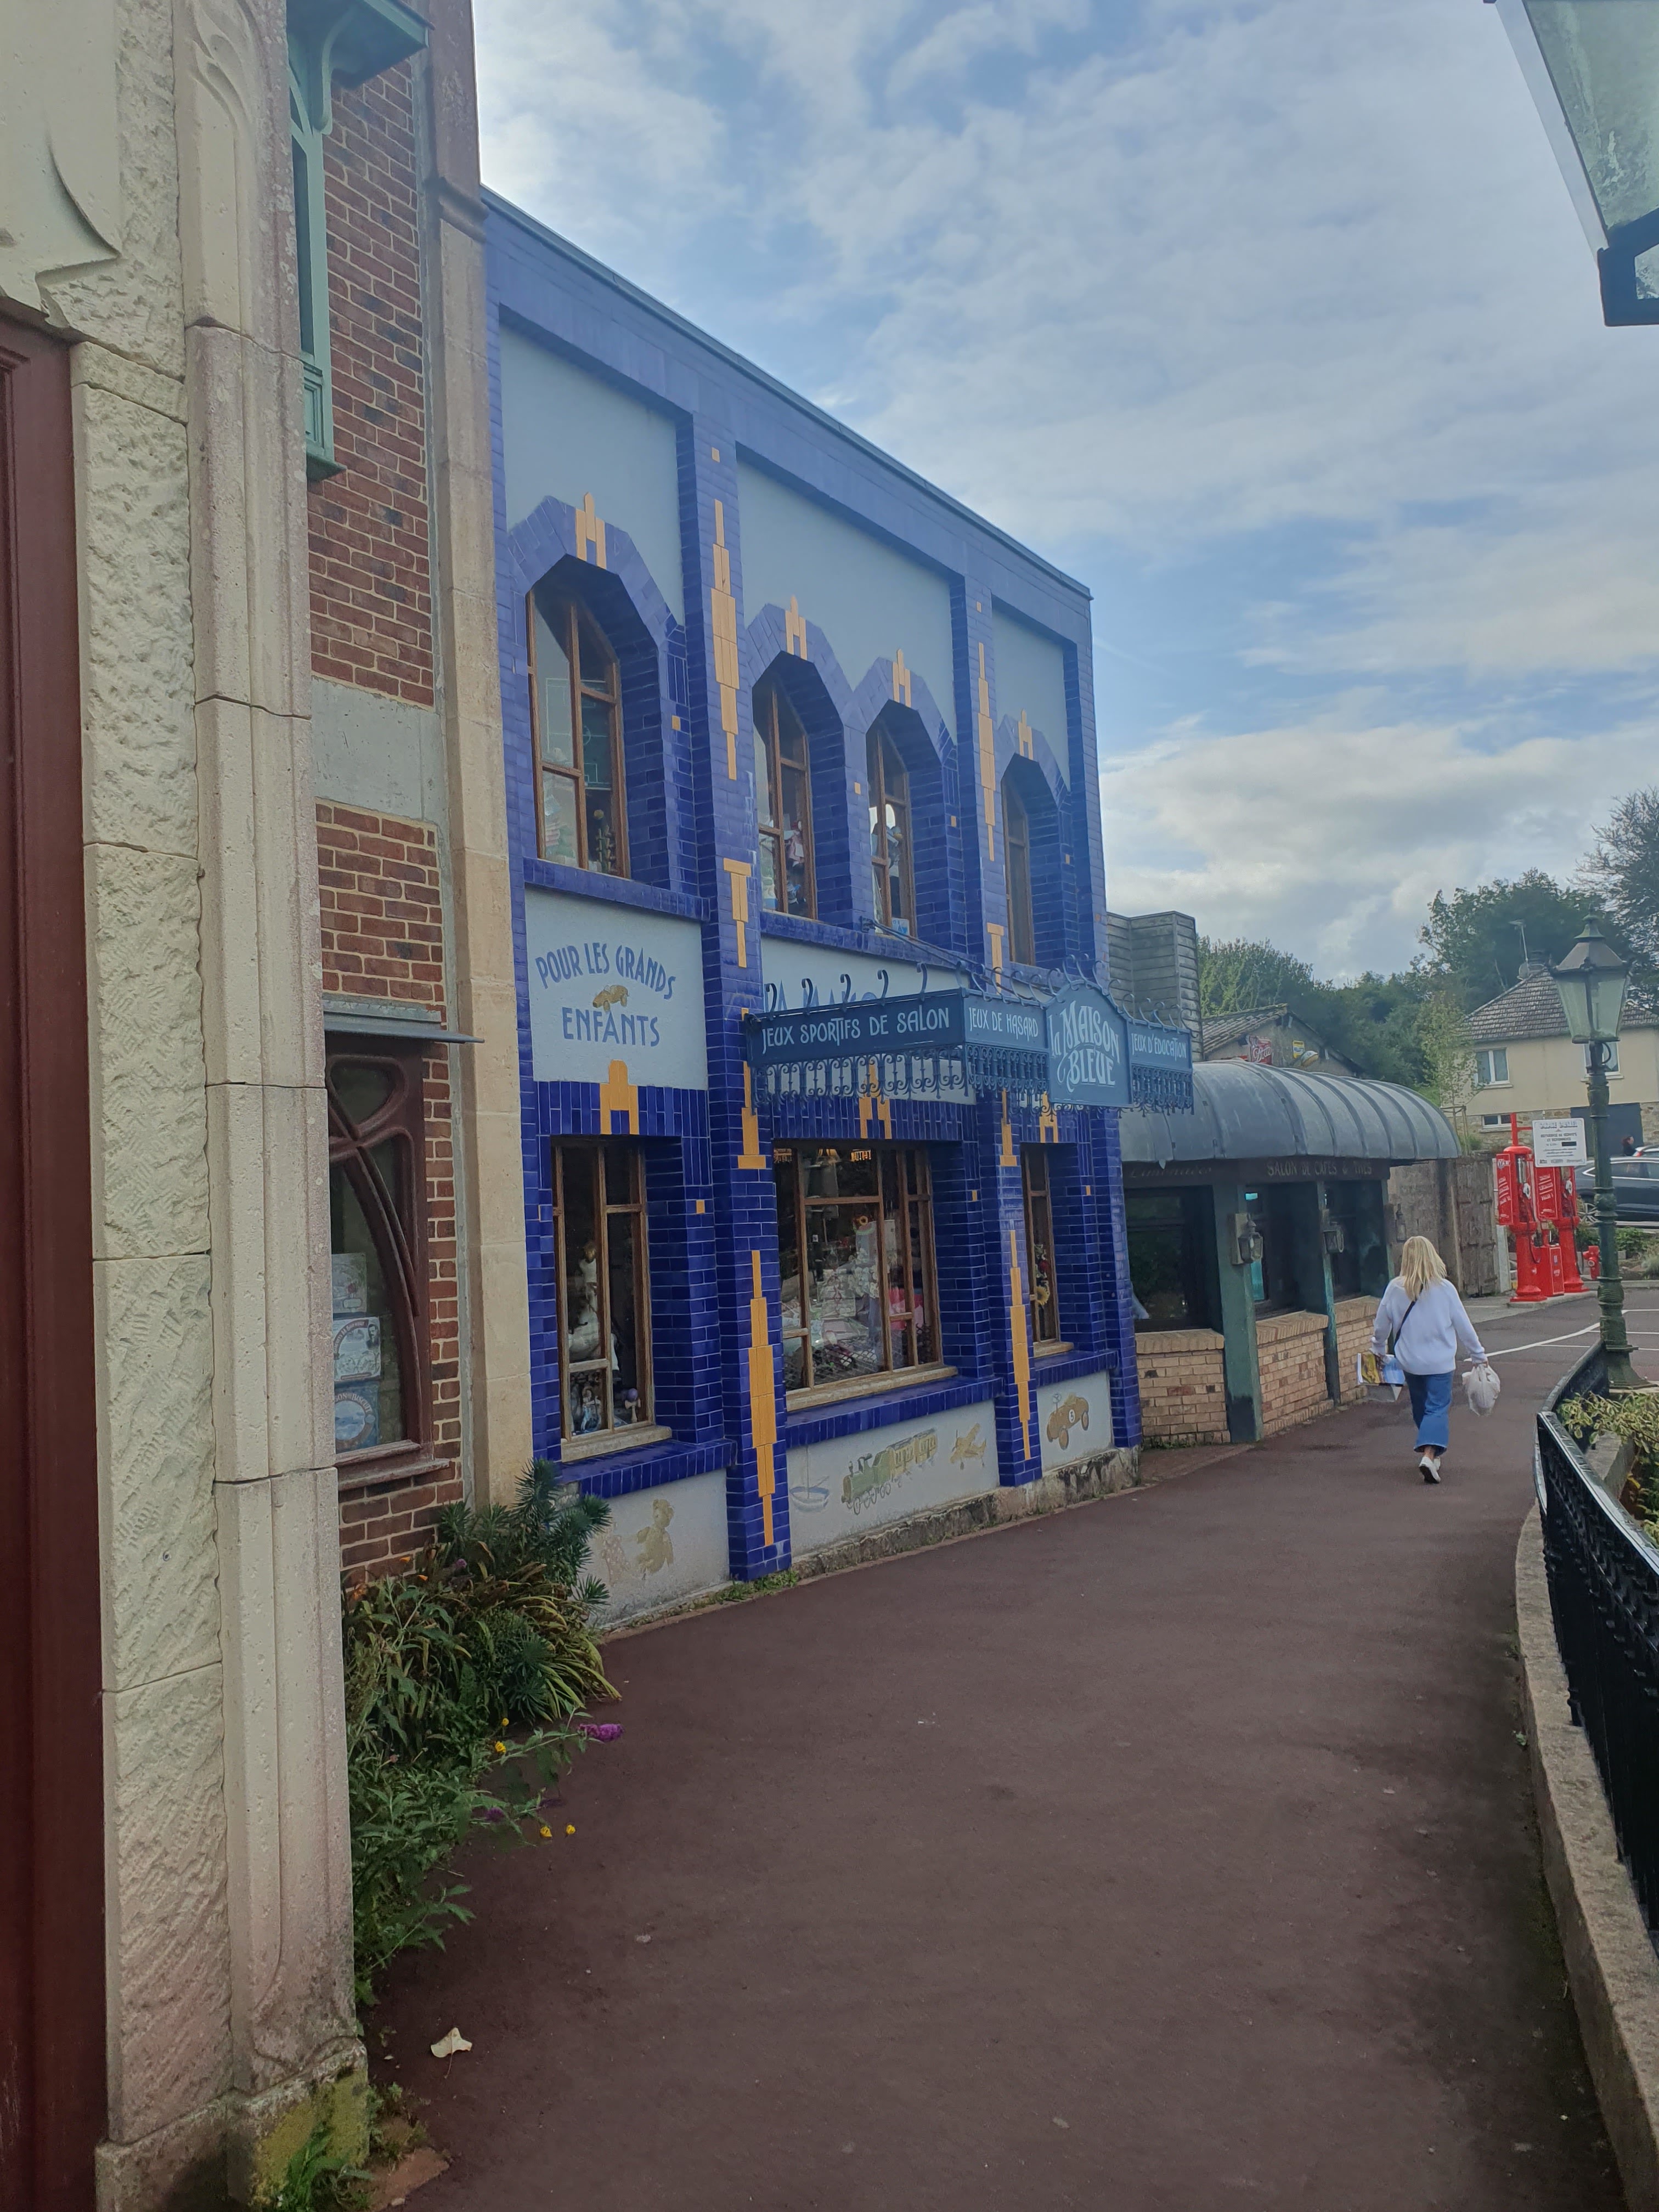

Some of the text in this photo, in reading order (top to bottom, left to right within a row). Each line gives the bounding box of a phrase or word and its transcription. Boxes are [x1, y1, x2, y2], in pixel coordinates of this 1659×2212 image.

[535, 942, 676, 1000] POUR LES GRANDS
[562, 1007, 660, 1047] ENFANTS
[762, 1005, 950, 1054] JEUX SPORTIFS DE SALON
[968, 1007, 1039, 1041] JEUX DE HASARD
[1057, 1001, 1120, 1083] MAISON
[1131, 1033, 1147, 1056] JEUX
[1066, 1048, 1115, 1092] BLEUE
[1267, 1161, 1297, 1176] SALON
